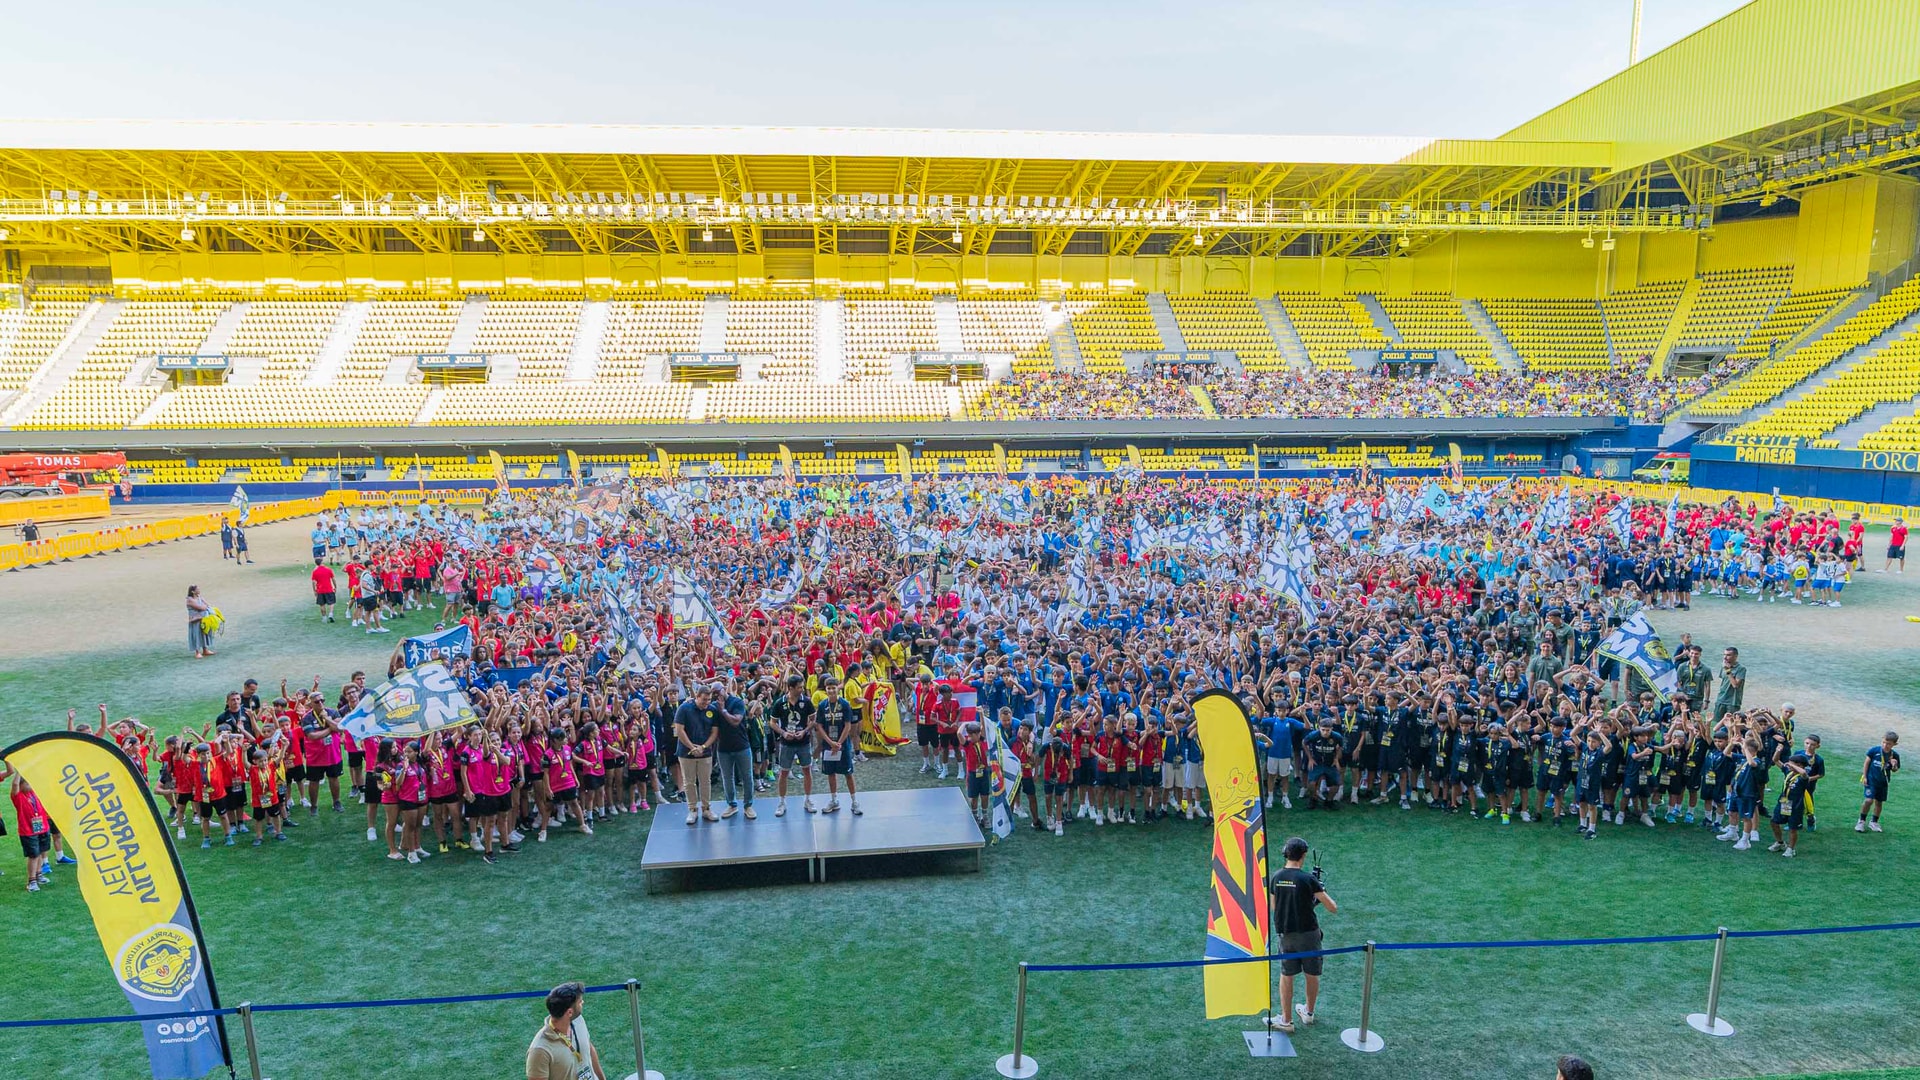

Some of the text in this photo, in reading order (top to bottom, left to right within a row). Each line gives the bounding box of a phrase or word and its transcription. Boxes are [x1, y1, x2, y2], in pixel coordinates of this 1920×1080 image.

[35, 456, 81, 466] TOMAS
[1735, 446, 1797, 465] PAMESA
[1862, 451, 1920, 473] PORC
